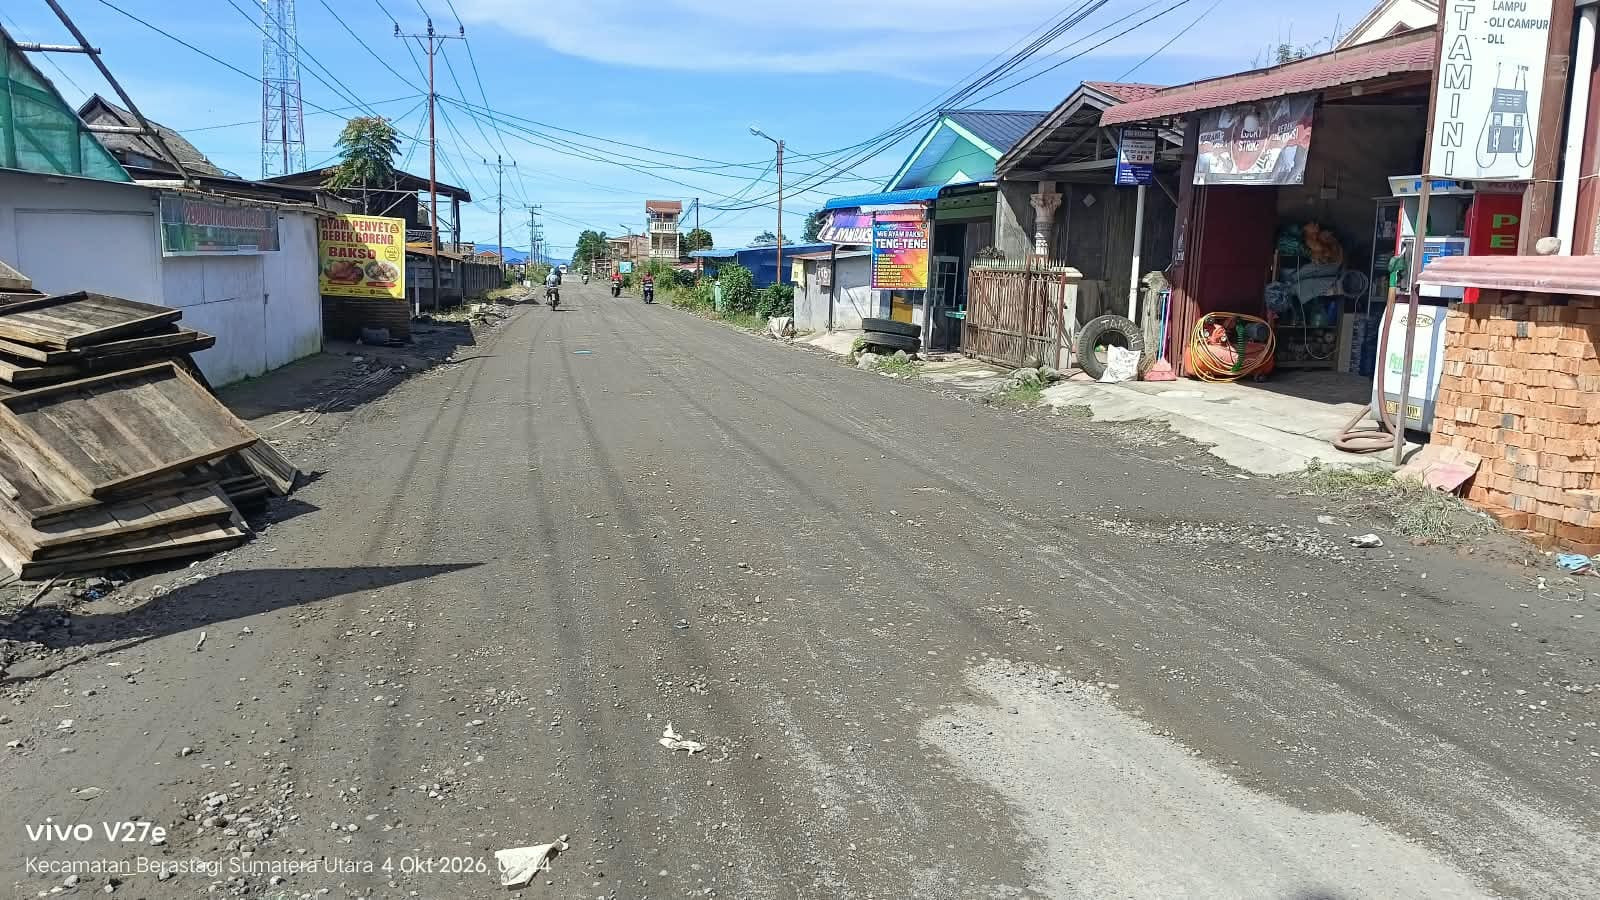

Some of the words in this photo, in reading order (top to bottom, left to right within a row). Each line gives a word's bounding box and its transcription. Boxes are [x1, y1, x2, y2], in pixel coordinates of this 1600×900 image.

[1492, 0, 1527, 12] LAMPU
[1507, 18, 1549, 30] CAMPUR
[1441, 0, 1475, 177] TAMINI
[320, 218, 350, 230] AYAM
[352, 220, 390, 233] PENYET
[874, 238, 927, 249] TENG-TENG
[328, 246, 377, 260] BAKSO
